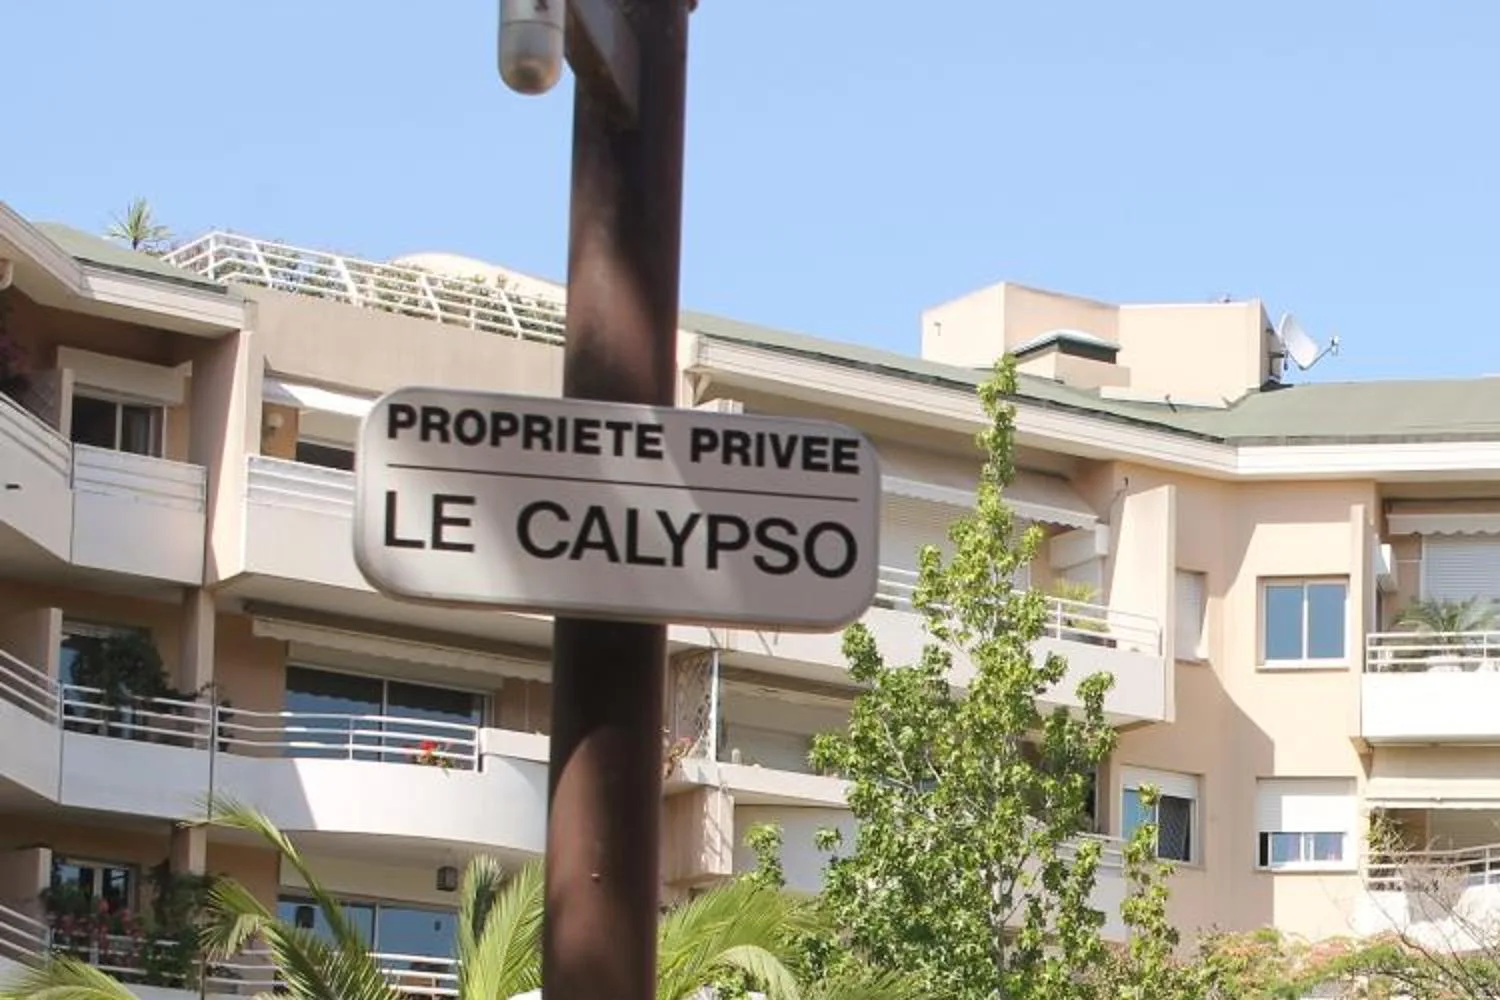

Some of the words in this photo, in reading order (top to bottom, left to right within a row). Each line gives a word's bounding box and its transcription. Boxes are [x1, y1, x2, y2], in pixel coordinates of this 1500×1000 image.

[387, 404, 663, 459] PROPRIETE
[690, 427, 860, 474] PRIVEE
[384, 491, 476, 553] LE
[516, 500, 858, 578] CALYPSO
